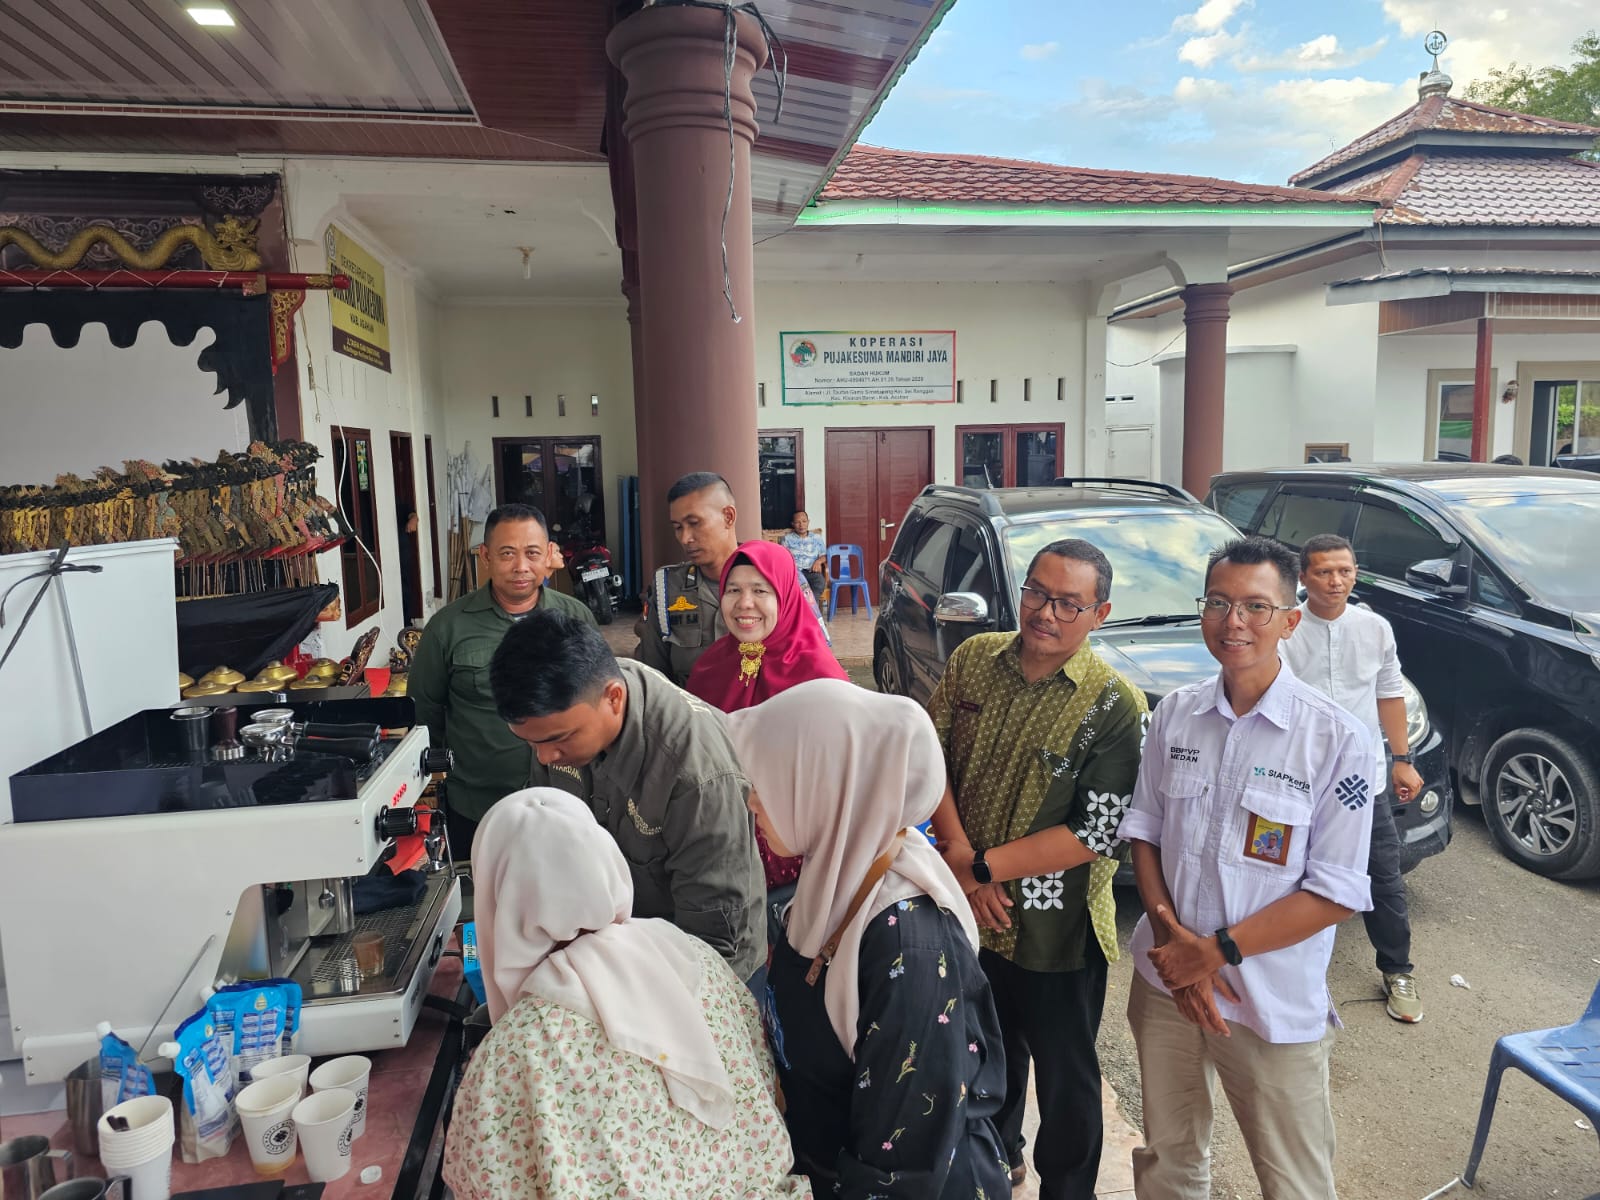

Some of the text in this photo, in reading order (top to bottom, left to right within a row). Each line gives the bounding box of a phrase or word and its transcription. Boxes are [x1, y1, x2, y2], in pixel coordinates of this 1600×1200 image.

[849, 337, 923, 347] KOPERASI
[823, 350, 948, 364] PUJAKESUMA MANDIRI JAYA
[1170, 753, 1198, 763] MEDAN
